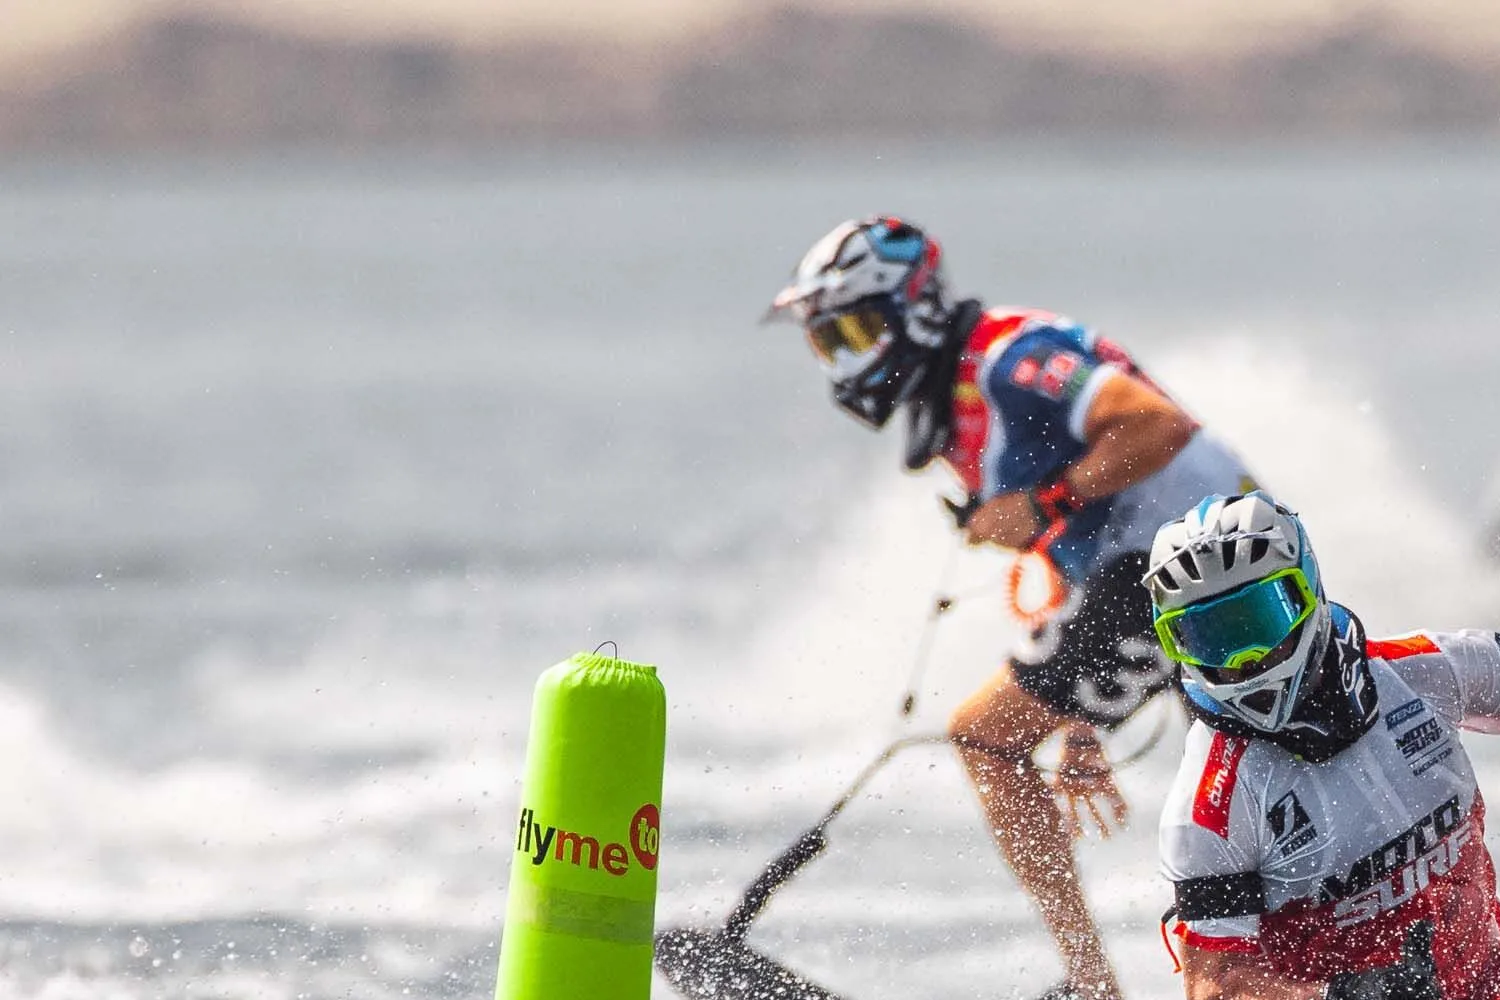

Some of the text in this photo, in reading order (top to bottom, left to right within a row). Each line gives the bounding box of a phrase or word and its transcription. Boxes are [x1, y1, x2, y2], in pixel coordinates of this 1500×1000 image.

[1395, 717, 1438, 750] MOTO
[1402, 727, 1443, 759] SURF
[1319, 794, 1460, 904] MOTO
[1335, 821, 1472, 928] SURF
